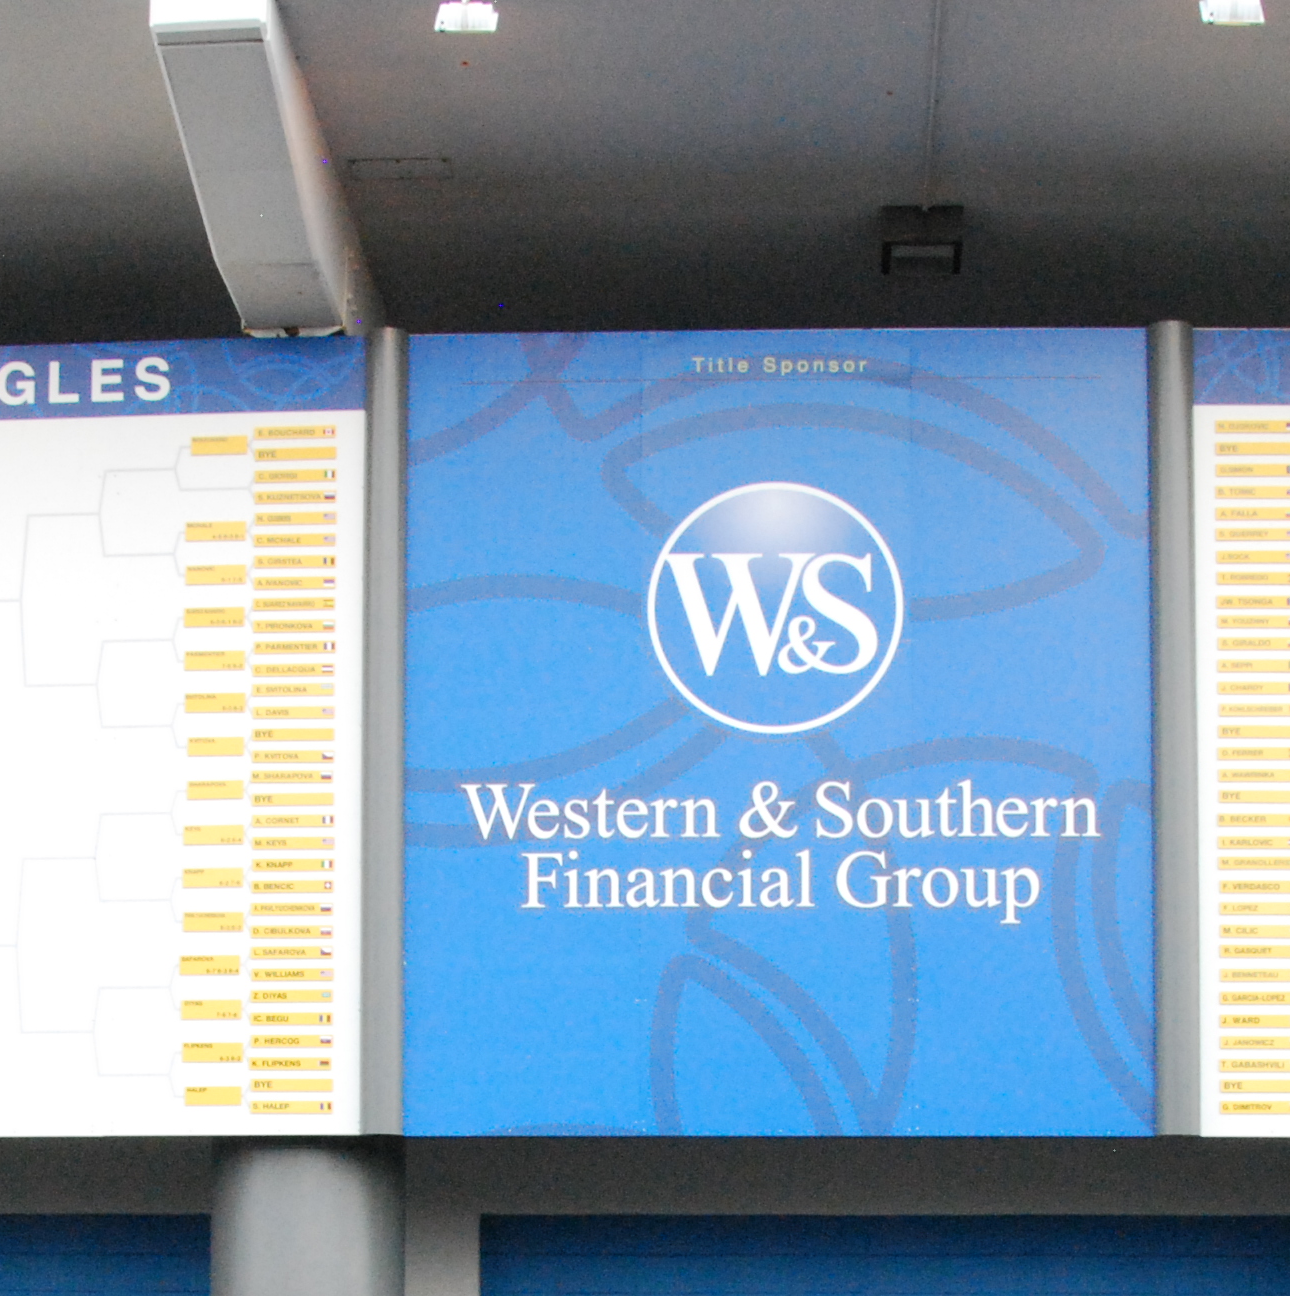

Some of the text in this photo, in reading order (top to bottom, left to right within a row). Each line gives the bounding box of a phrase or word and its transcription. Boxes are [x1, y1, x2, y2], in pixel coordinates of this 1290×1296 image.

[693, 357, 868, 374] Title Sponsor
[664, 553, 879, 676] W&S
[461, 779, 1100, 840] Western & Southern
[520, 850, 1041, 923] Financial Group
